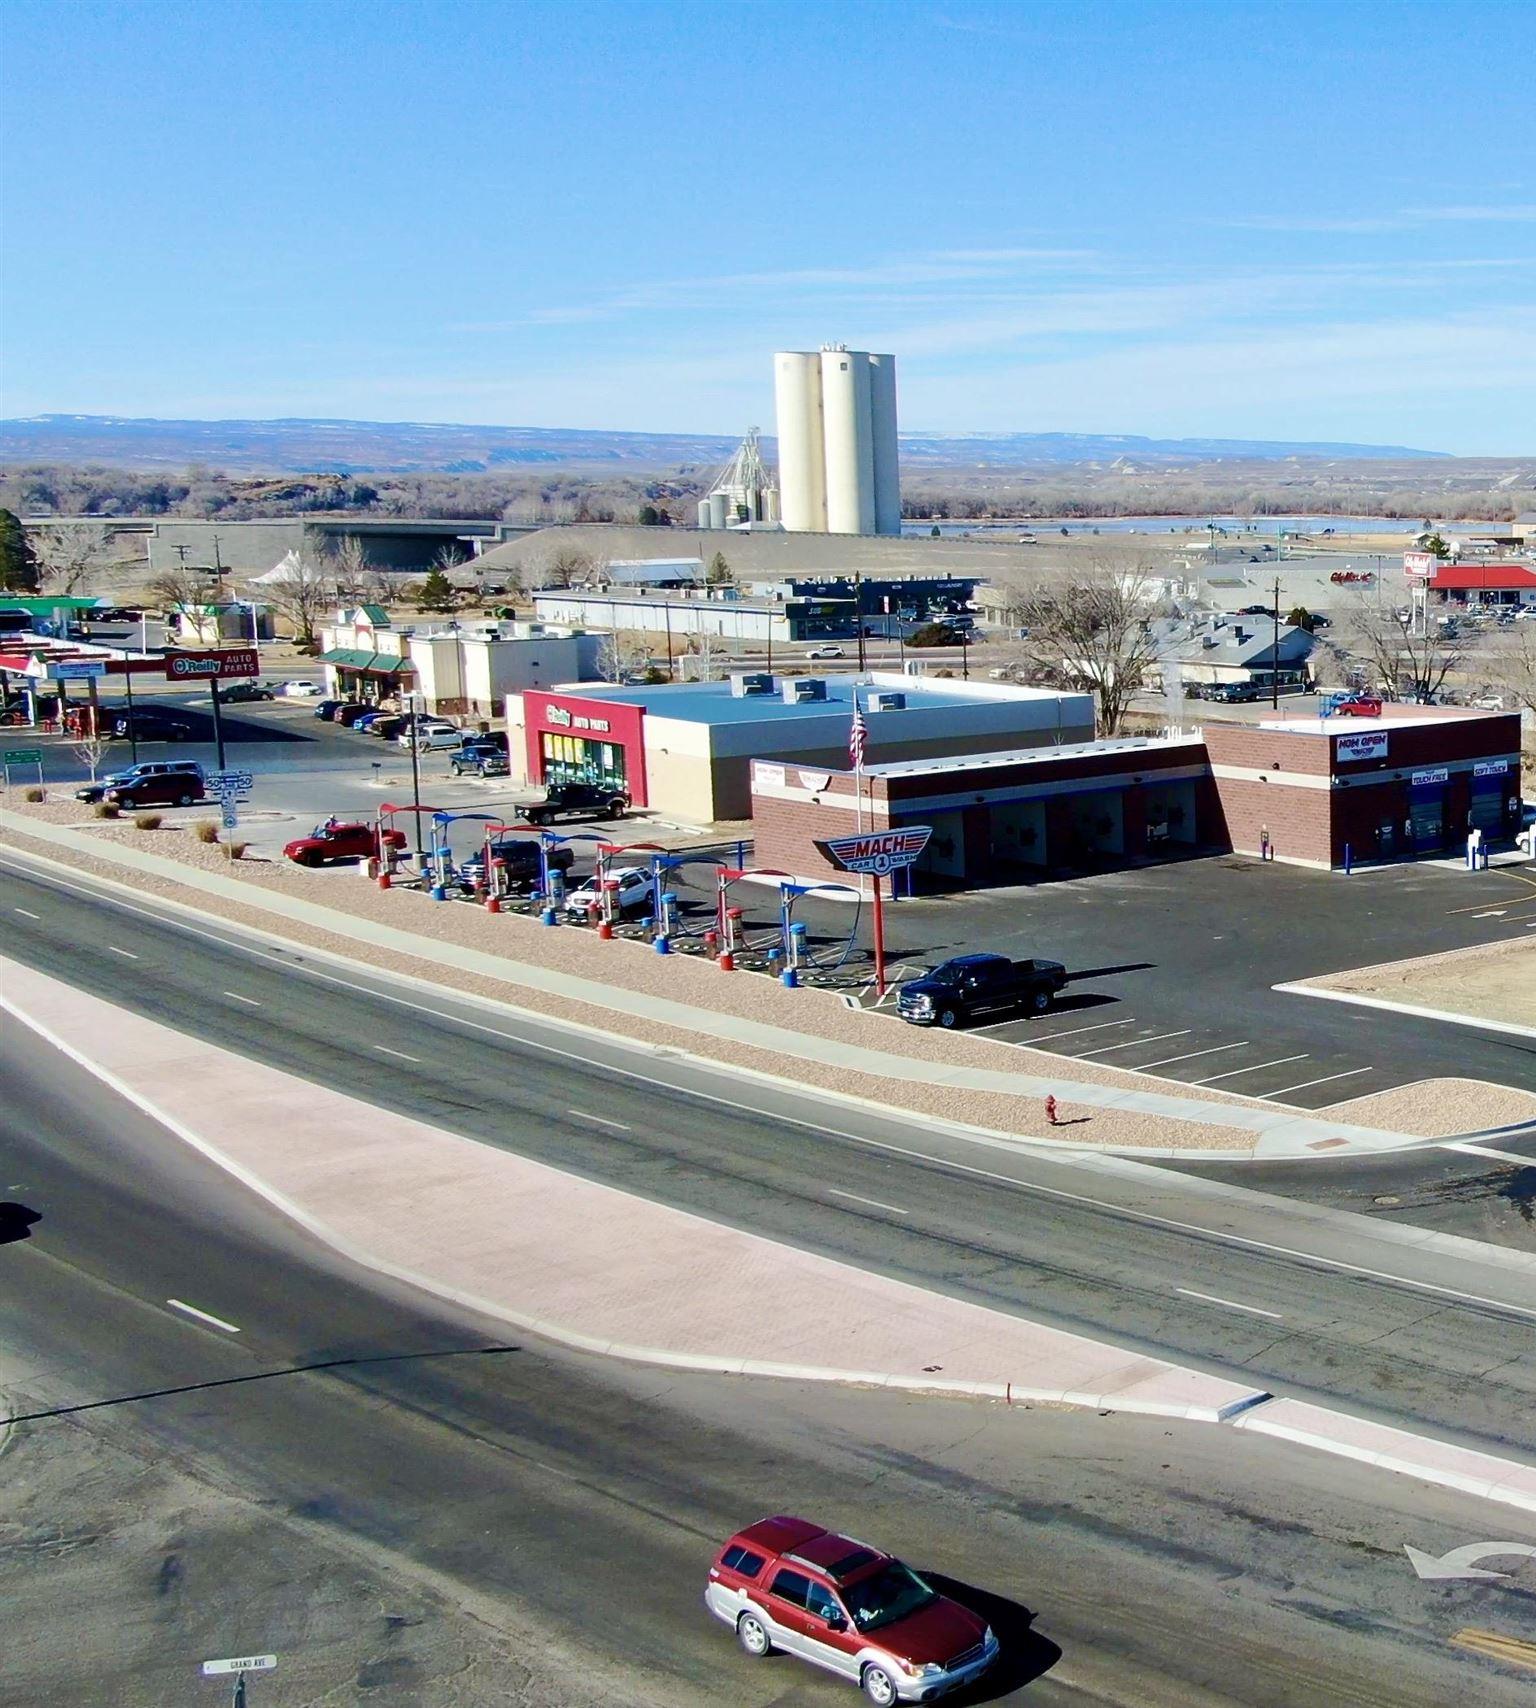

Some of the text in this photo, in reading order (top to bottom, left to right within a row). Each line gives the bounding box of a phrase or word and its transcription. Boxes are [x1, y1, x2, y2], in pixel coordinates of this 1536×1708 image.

[173, 655, 251, 675] O'Reilly AUTO
[224, 664, 255, 672] PARTS
[590, 719, 609, 732] PARTS
[1338, 735, 1386, 749] NOW OPEN
[1413, 775, 1432, 785] TOUCH
[855, 835, 906, 858] MACH
[851, 861, 870, 869] CAR
[891, 855, 916, 863] WASH
[230, 1657, 266, 1669] GRAND AVE
